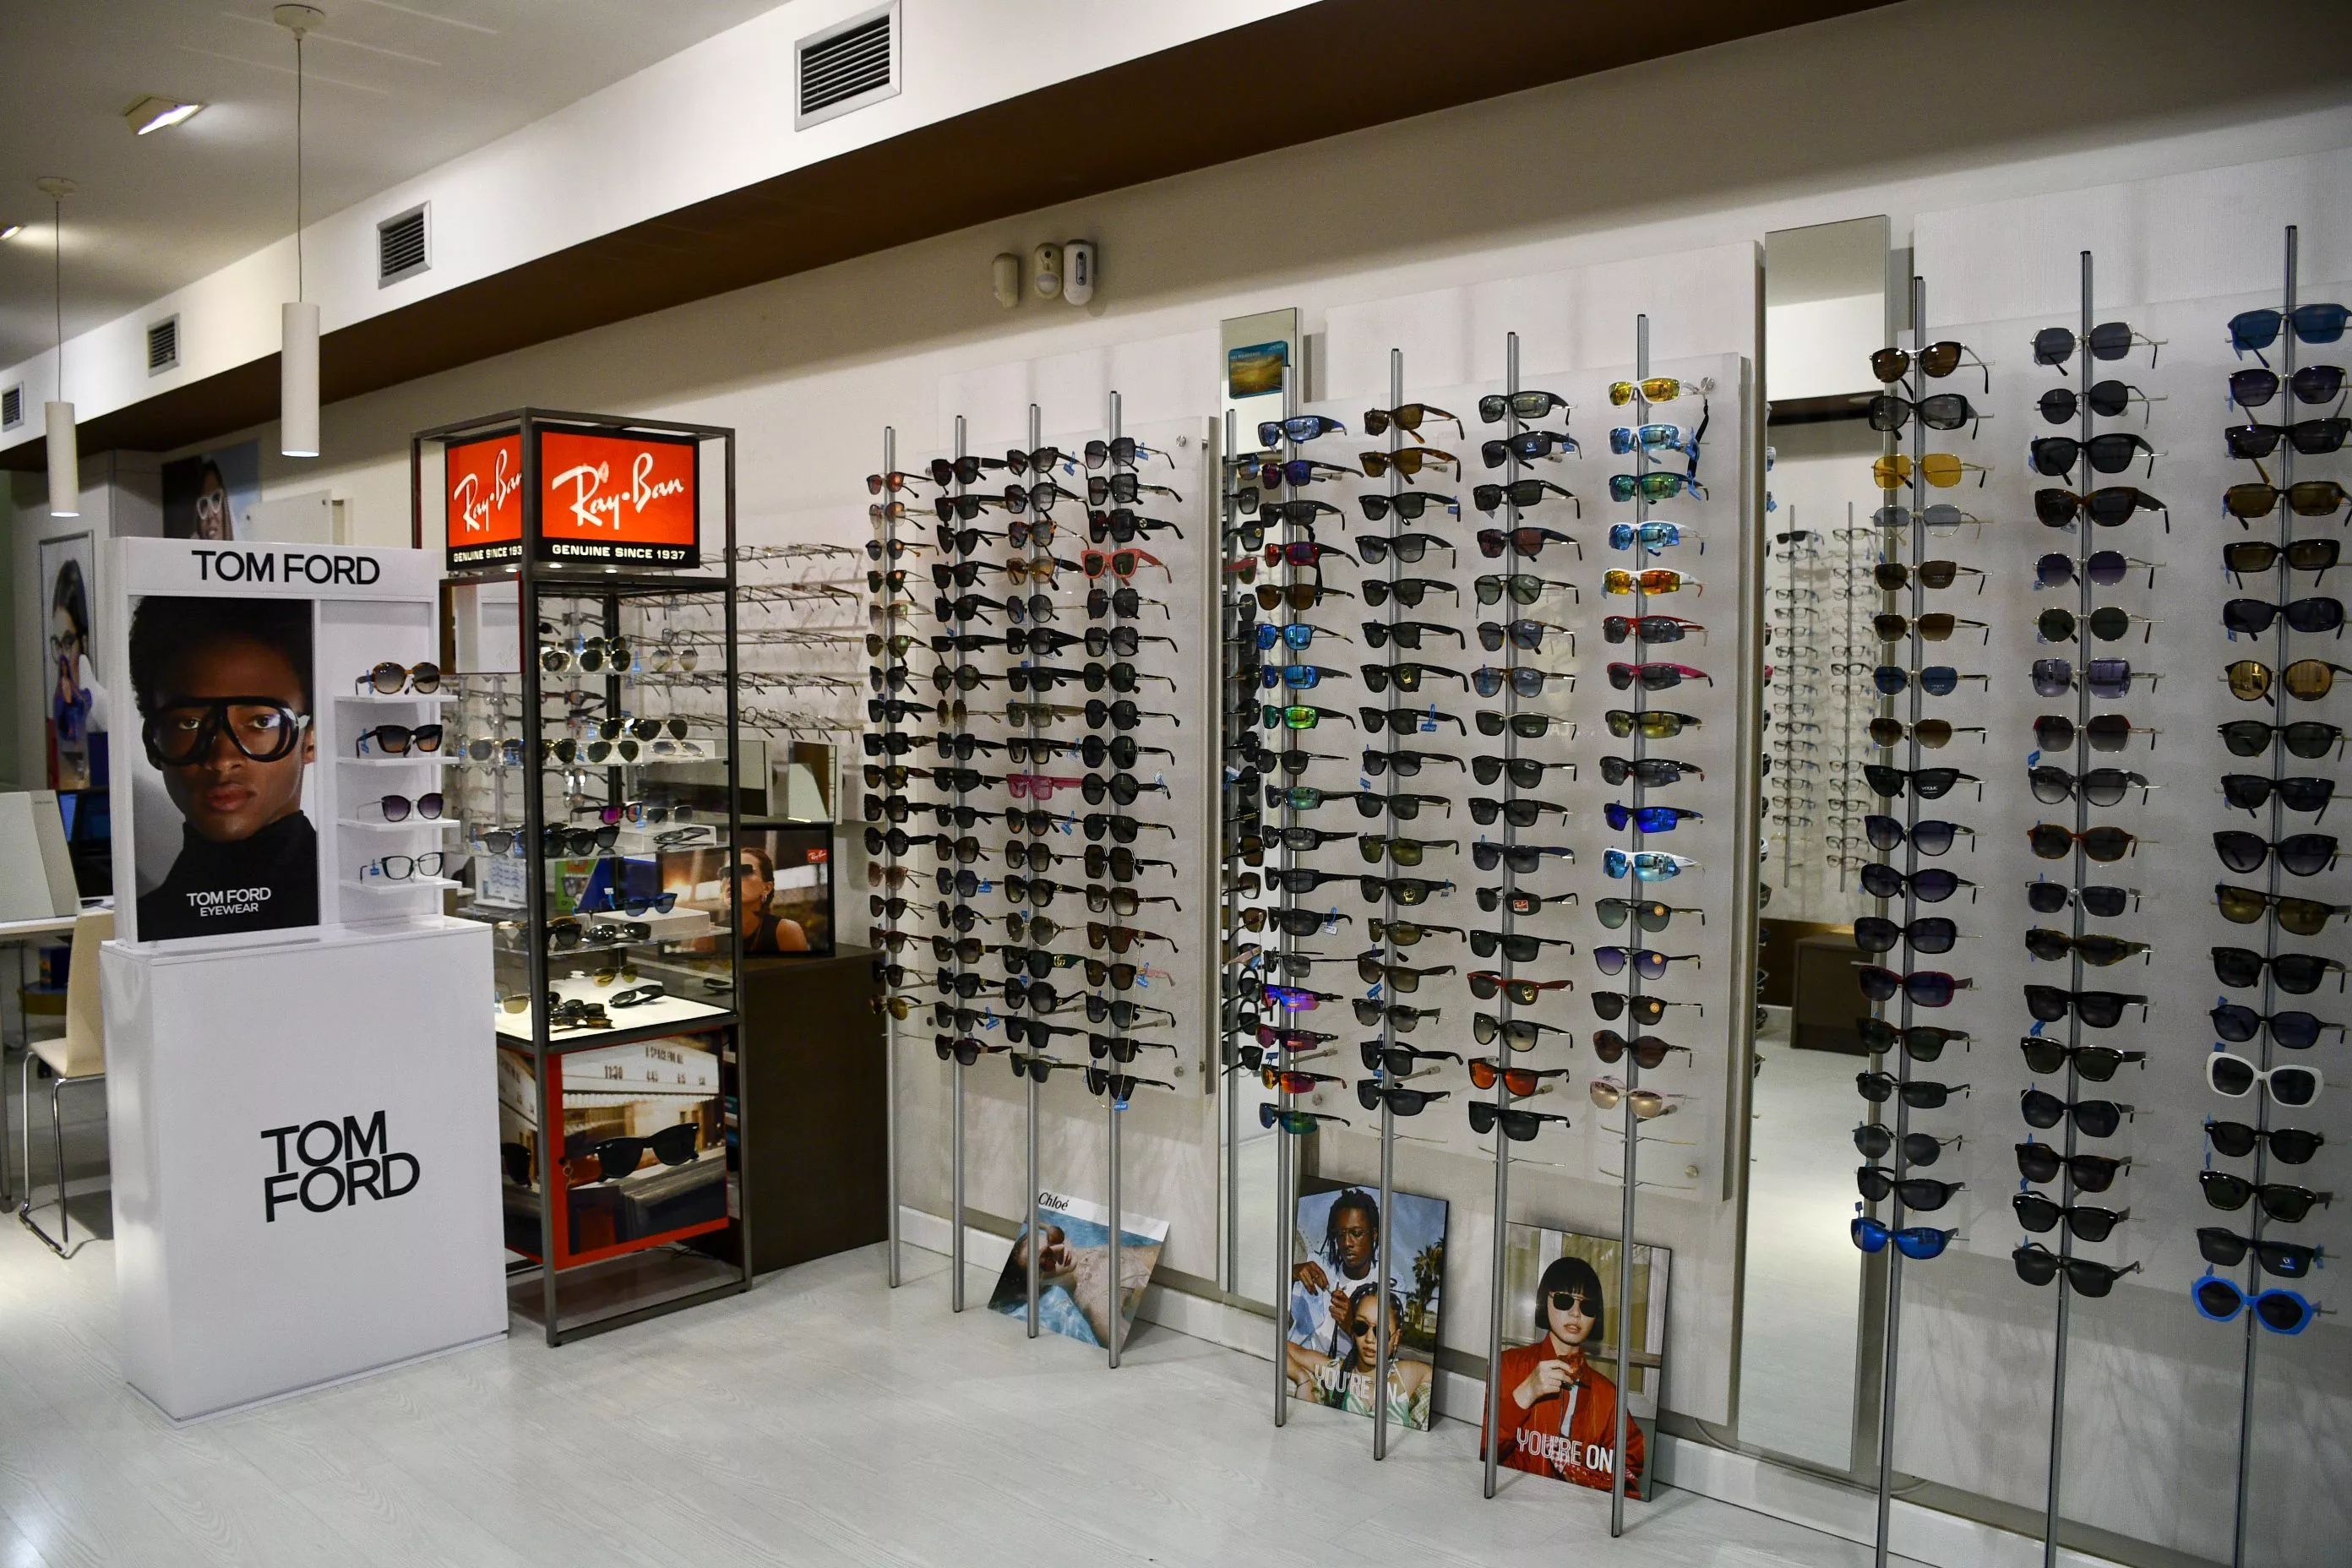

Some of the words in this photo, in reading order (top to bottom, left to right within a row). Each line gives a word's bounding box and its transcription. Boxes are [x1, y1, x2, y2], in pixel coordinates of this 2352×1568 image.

[454, 549, 484, 563] GENUINE
[486, 547, 508, 558] SINCE
[509, 545, 522, 556] 193
[552, 544, 611, 557] GENUINE
[615, 547, 653, 559] SINCE
[656, 549, 686, 560] 1937
[191, 550, 275, 582] TOM
[284, 553, 380, 585] FORD
[186, 890, 224, 906] TOM
[226, 887, 271, 904] FORD
[199, 902, 259, 917] EYEWEAR
[260, 1109, 388, 1173] TOM
[264, 1152, 421, 1222] FORD
[1038, 1192, 1070, 1211] Chloé
[1314, 1364, 1372, 1400] YOU'RE
[1516, 1426, 1583, 1467] YOU'RE
[1586, 1444, 1614, 1474] ON
